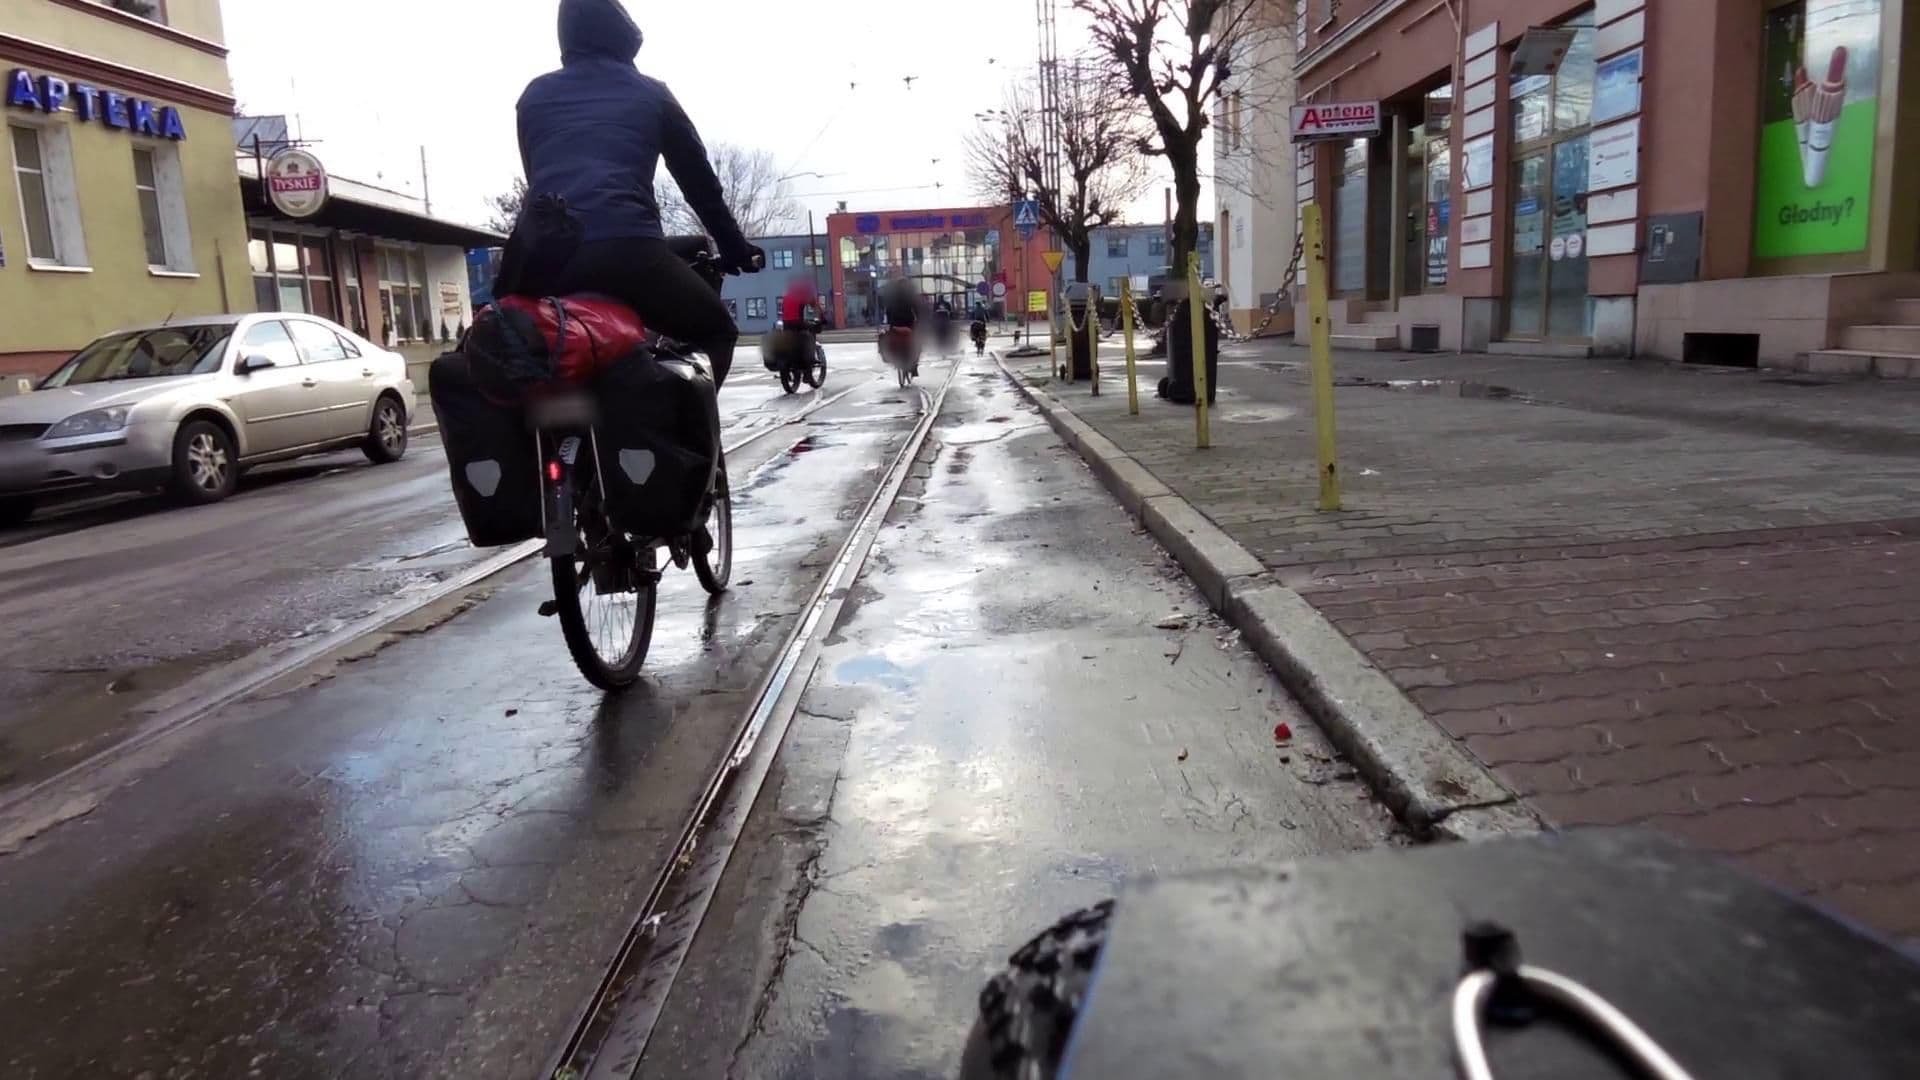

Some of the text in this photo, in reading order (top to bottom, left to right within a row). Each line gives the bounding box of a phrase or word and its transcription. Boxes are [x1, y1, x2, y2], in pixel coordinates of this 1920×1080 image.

[7, 68, 186, 140] APTEKA
[1299, 105, 1375, 130] Antena
[274, 177, 318, 190] TYSKIE
[1779, 197, 1855, 225] Głodny?
